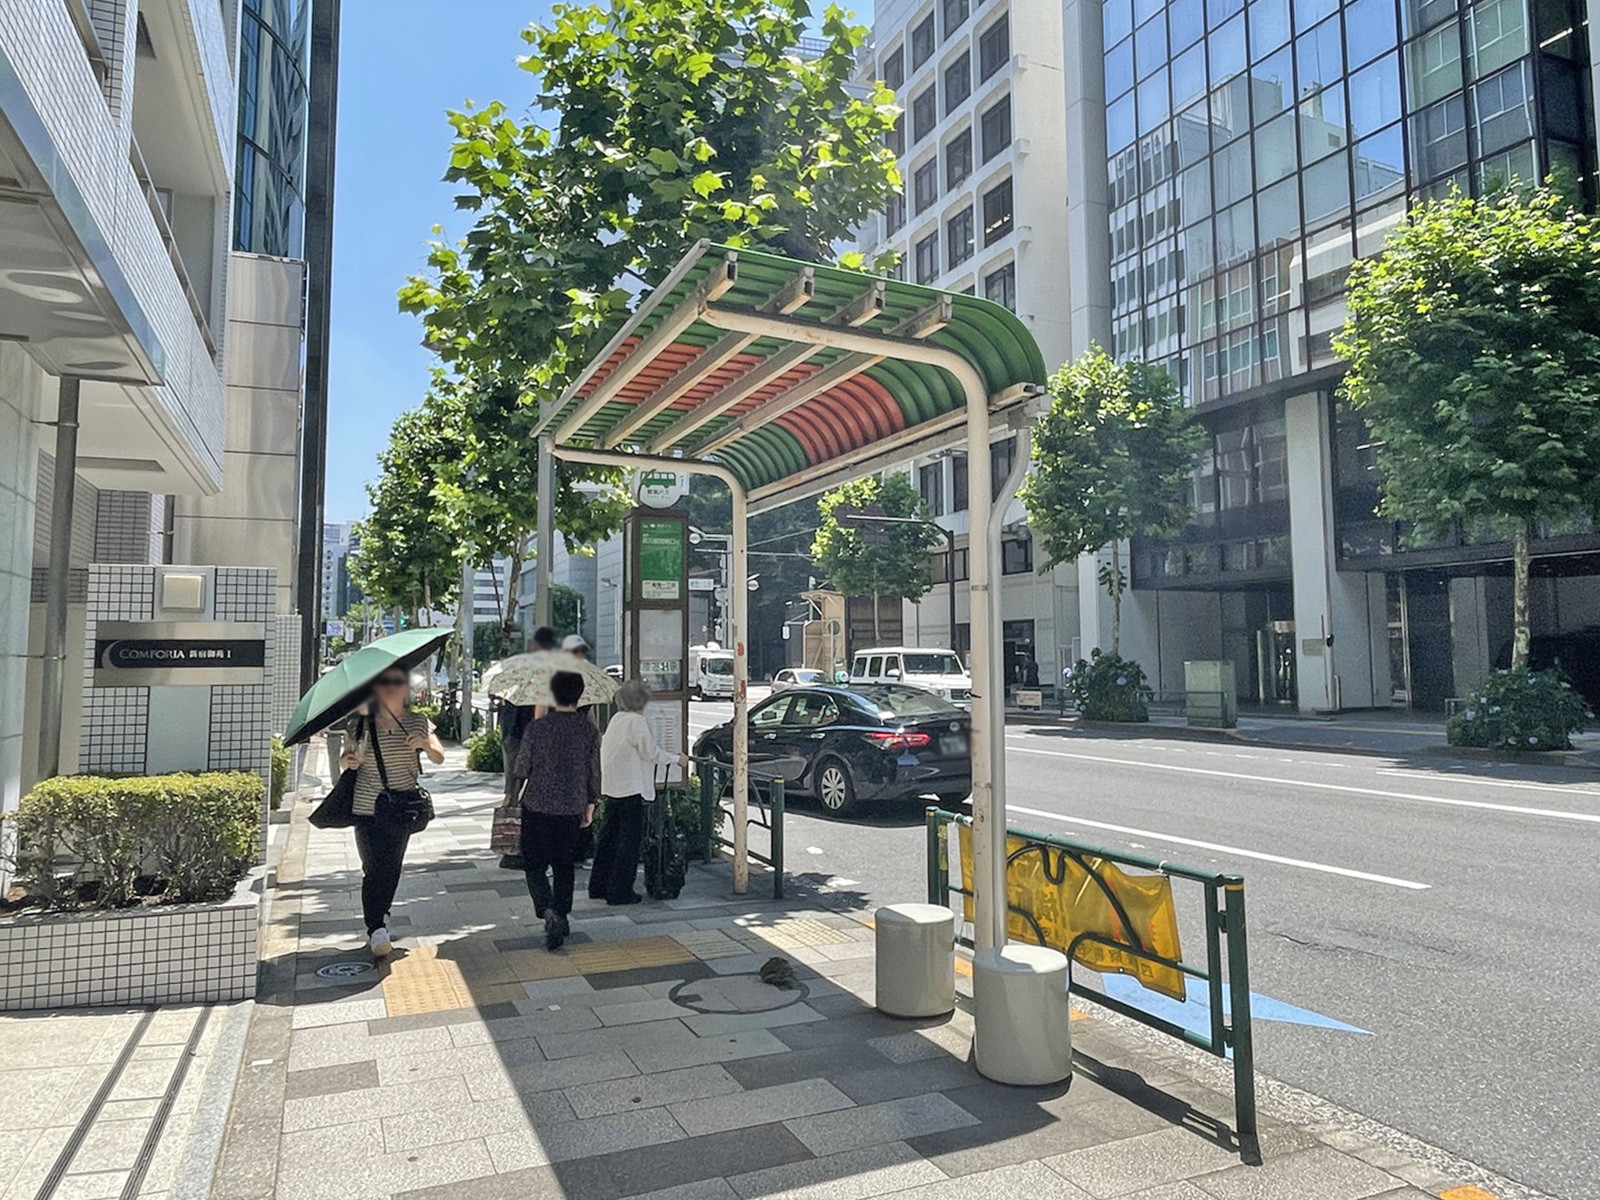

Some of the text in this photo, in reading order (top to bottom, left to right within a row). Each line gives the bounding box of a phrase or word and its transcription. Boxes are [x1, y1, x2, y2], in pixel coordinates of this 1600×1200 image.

[119, 649, 185, 659] COMFORIA
[189, 650, 224, 659] 新宿御苑
